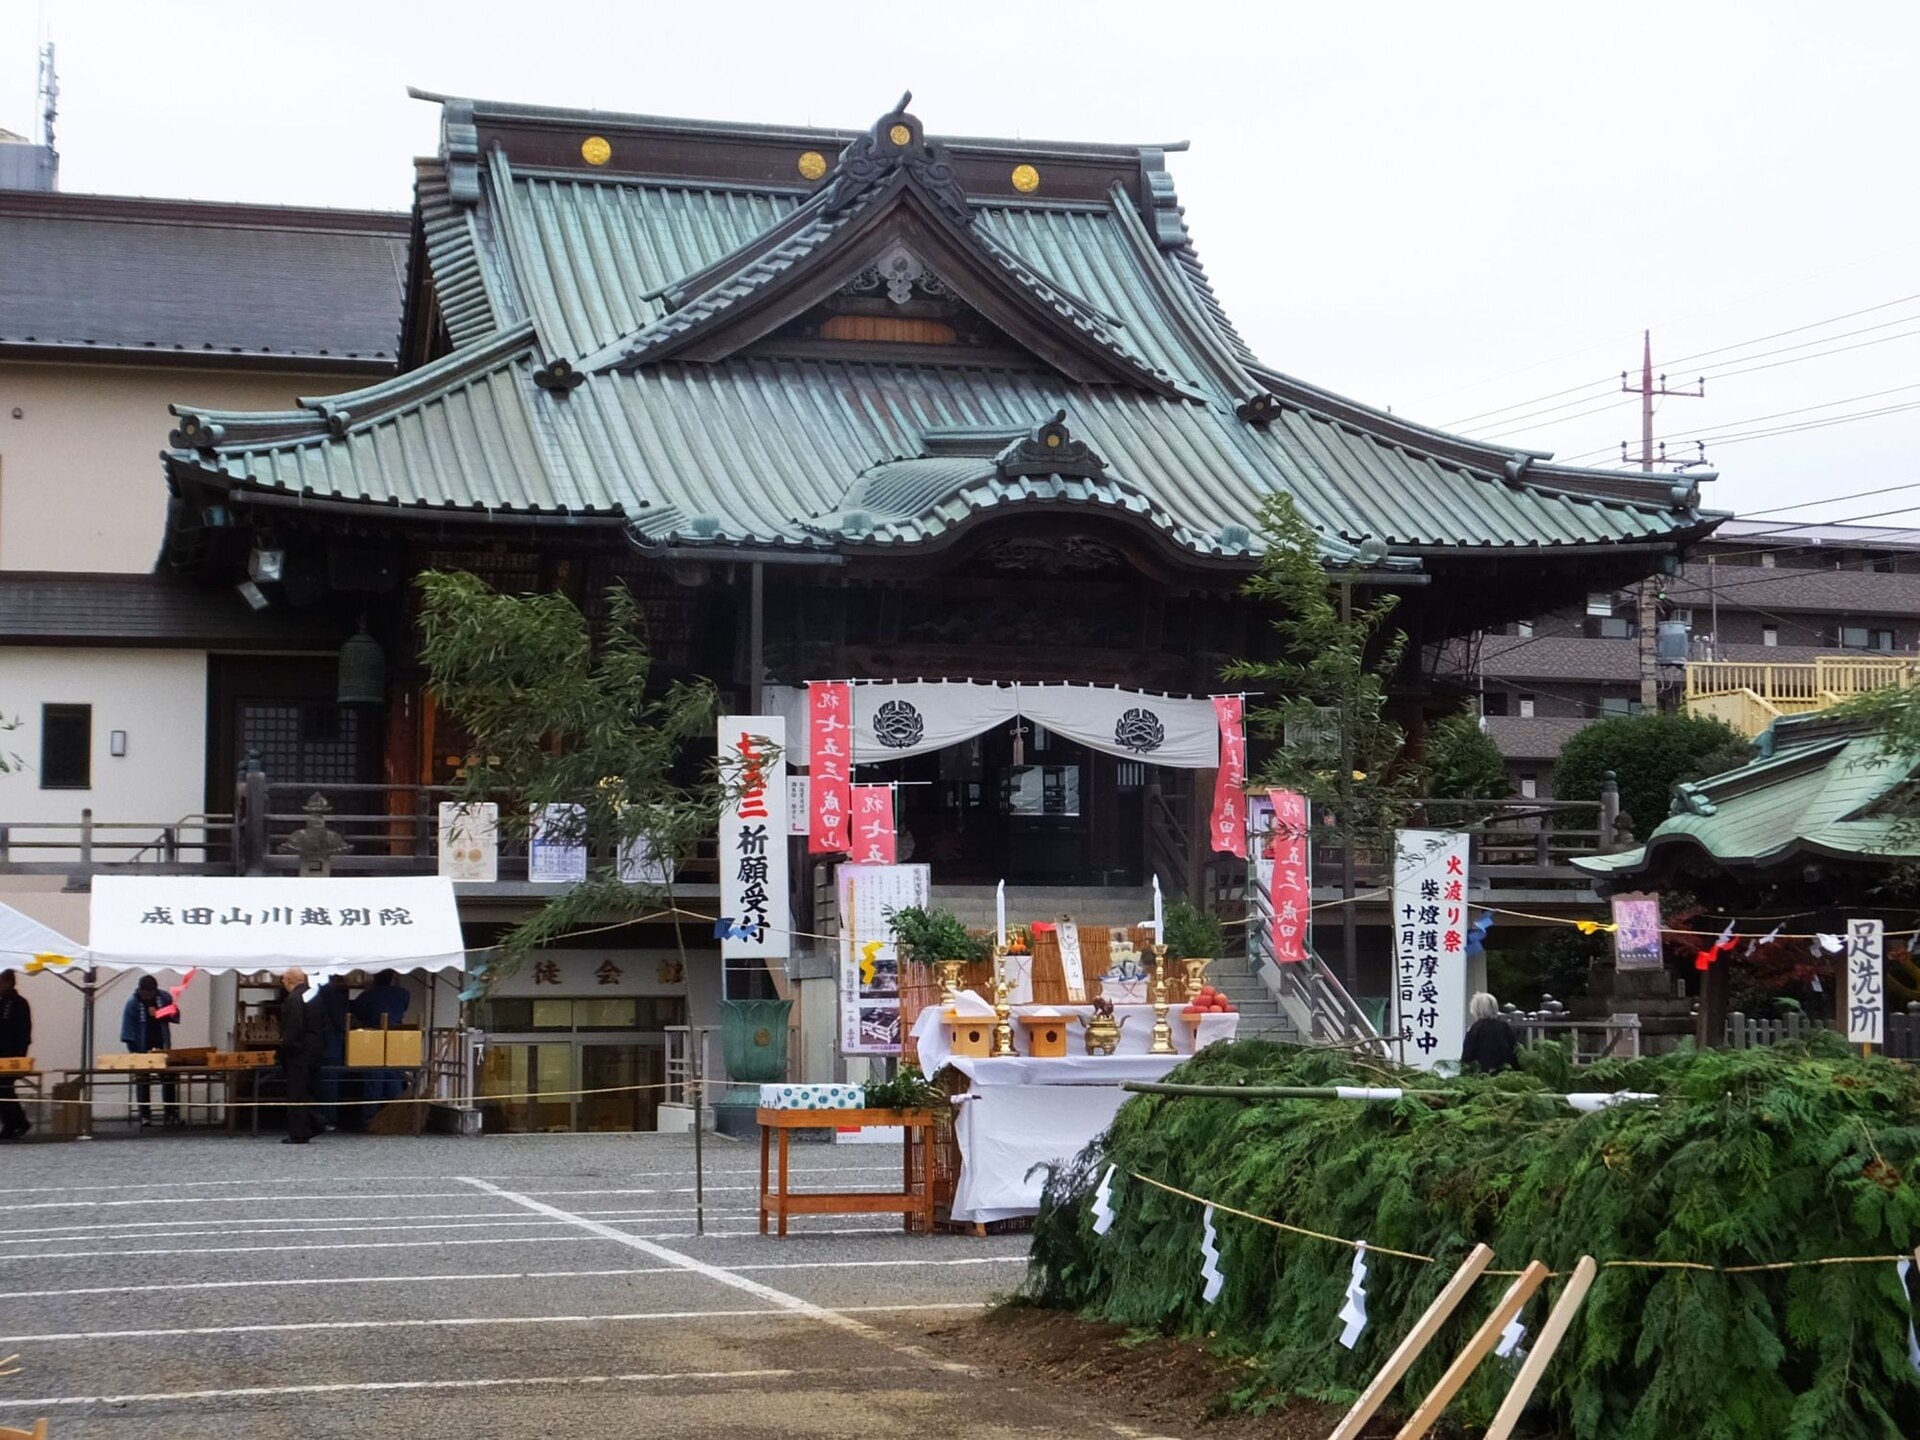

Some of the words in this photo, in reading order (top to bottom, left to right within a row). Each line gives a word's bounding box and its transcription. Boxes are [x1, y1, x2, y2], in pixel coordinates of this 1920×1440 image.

[140, 906, 414, 927] 成田山川越別院
[1400, 903, 1416, 1002] 十一月二十三日
[1443, 855, 1464, 953] 火渡り祭
[484, 958, 686, 985] 徒会館
[1416, 878, 1440, 1055] 柴燈護摩受付中
[1849, 922, 1881, 1040] 足洗所
